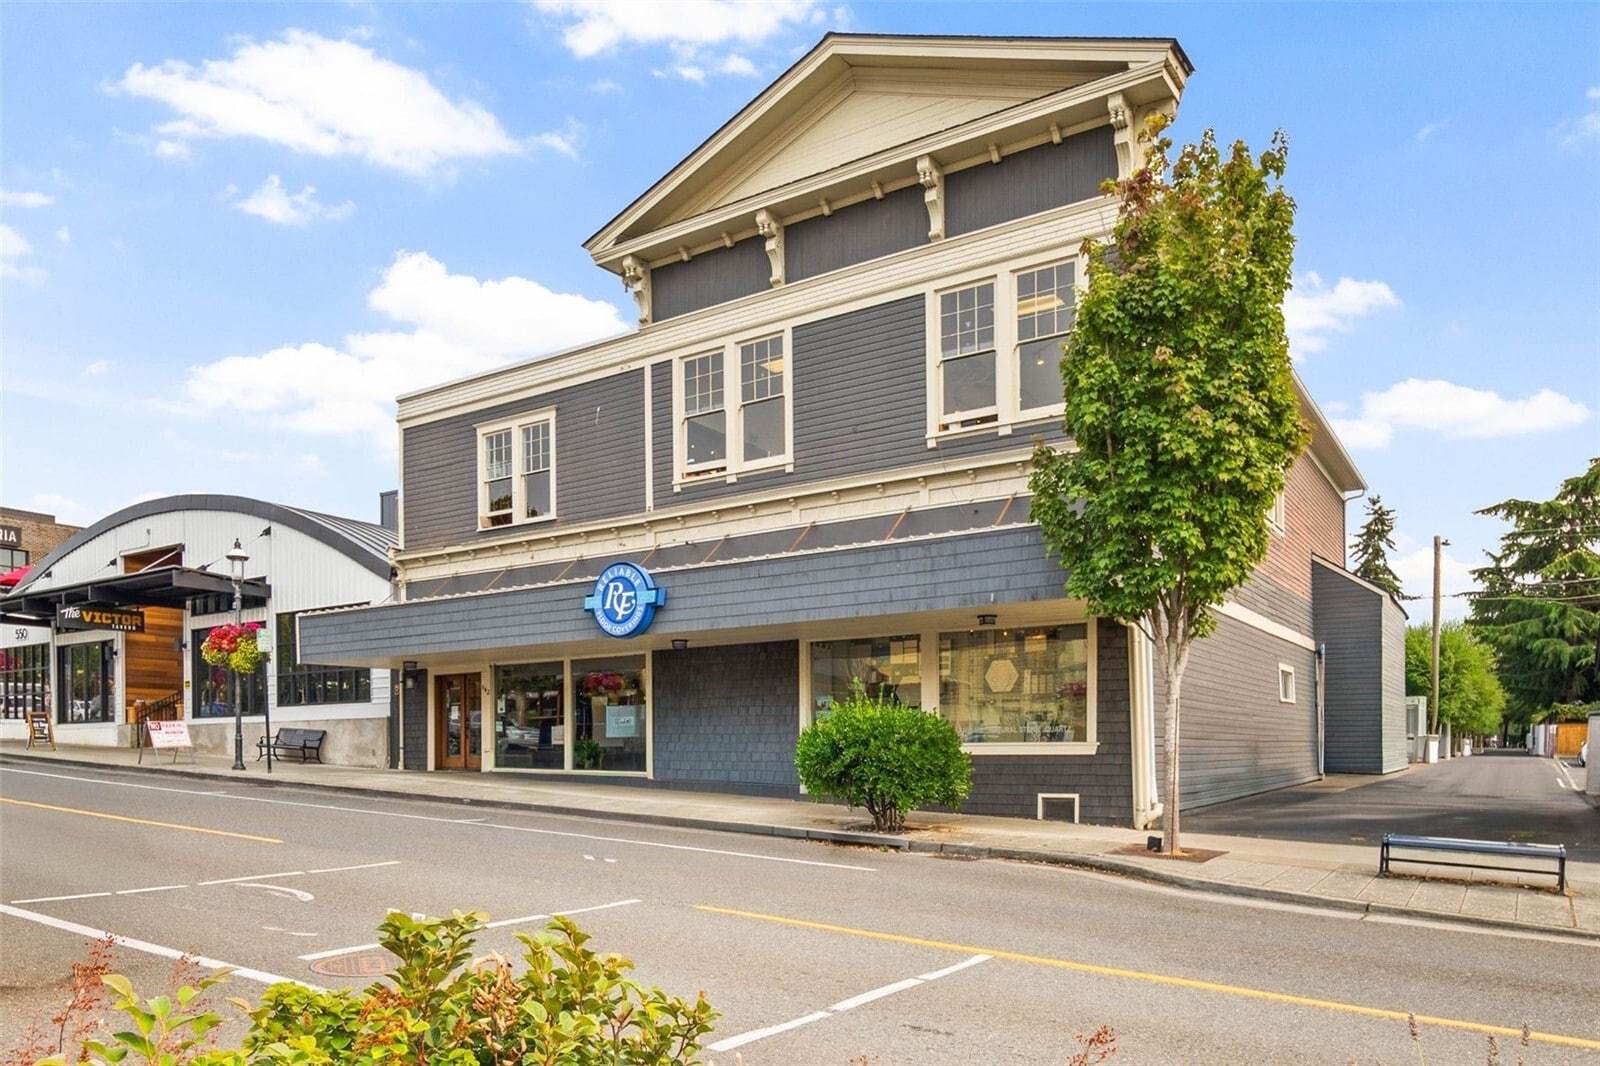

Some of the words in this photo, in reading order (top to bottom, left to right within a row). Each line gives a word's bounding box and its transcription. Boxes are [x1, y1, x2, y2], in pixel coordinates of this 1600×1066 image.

[597, 567, 641, 591] RELIABLE
[60, 606, 81, 619] The
[82, 610, 142, 626] VICTOR
[612, 606, 644, 633] COVERINGS
[15, 627, 28, 640] 550
